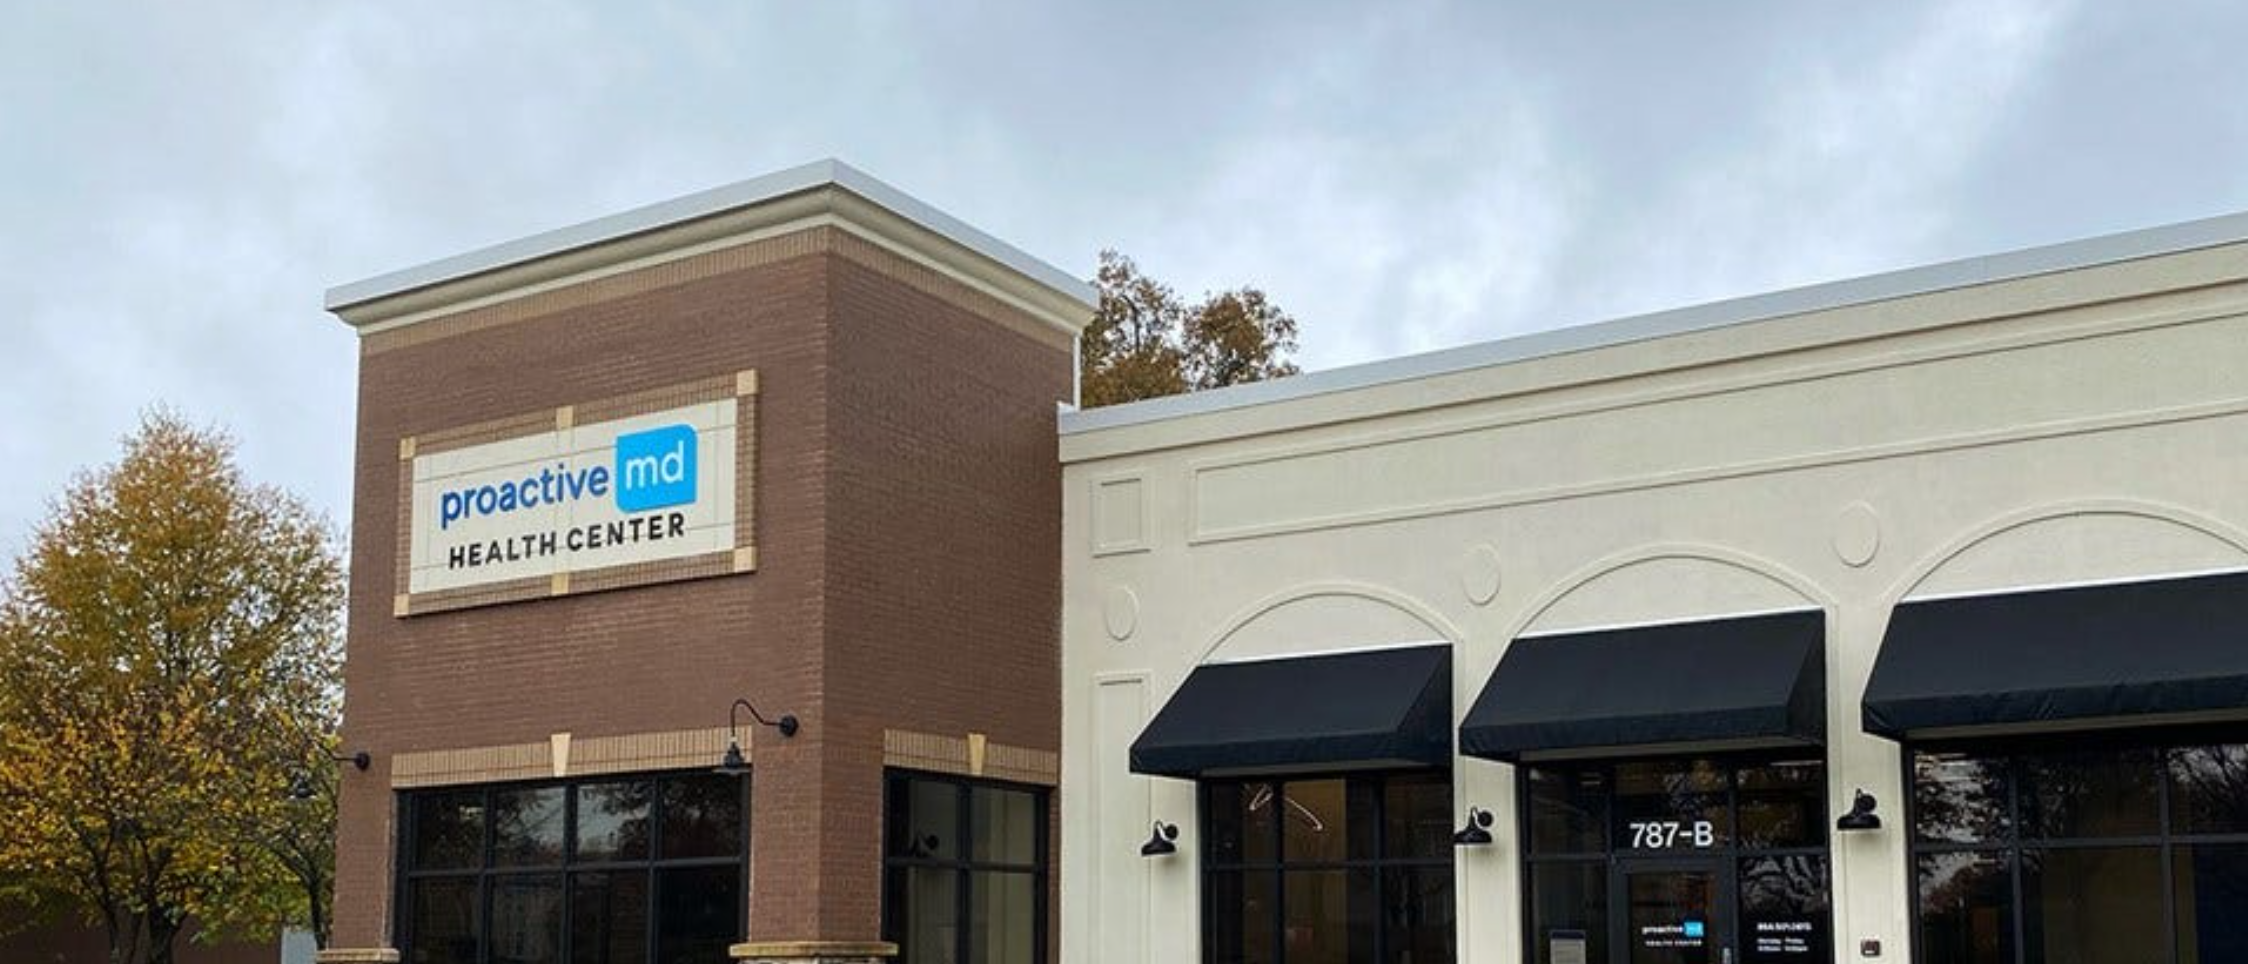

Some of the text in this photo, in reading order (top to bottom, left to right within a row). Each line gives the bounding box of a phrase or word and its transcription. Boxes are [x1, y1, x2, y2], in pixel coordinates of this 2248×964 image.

[440, 440, 685, 530] proactive md
[448, 512, 685, 569] HEALTH CENTER
[1630, 820, 1714, 848] 787-B
